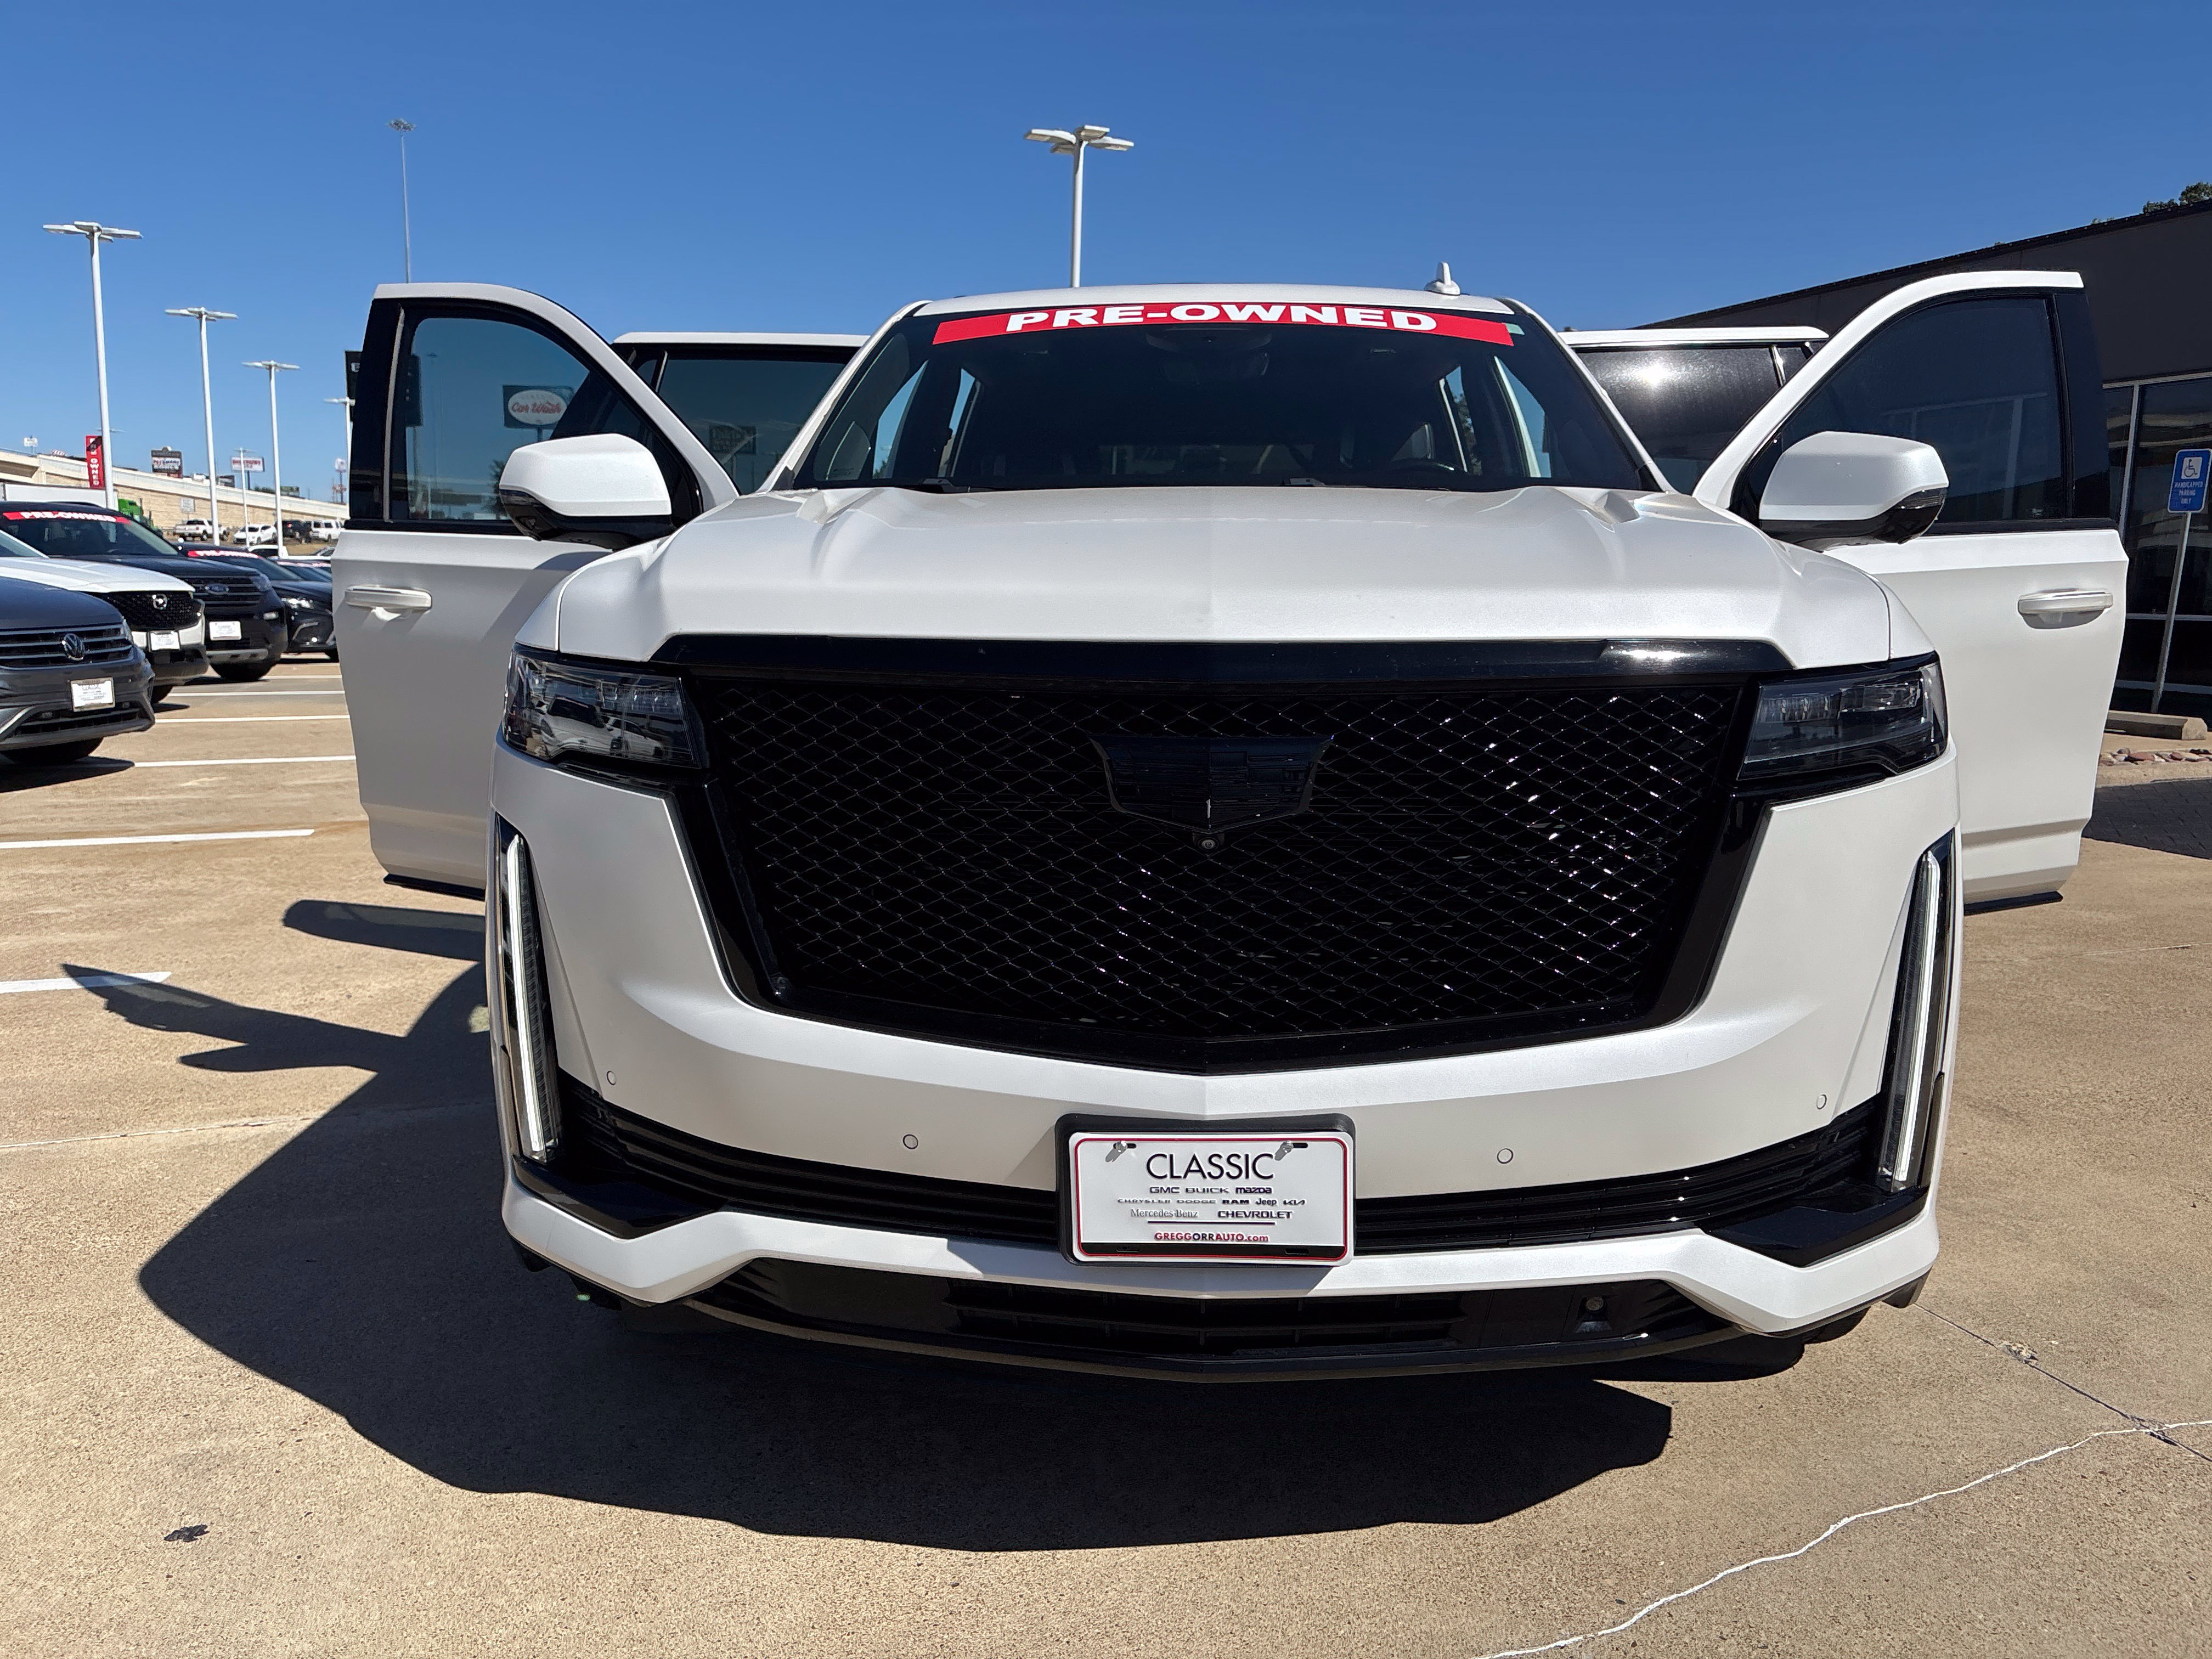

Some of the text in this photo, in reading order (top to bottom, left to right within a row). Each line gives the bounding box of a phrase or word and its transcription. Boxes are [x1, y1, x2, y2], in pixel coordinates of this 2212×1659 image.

[1006, 304, 1437, 332] PRE-OWNED
[512, 401, 561, 414] Car Wash
[20, 511, 117, 522] PRE-OWNED
[1146, 1153, 1274, 1180] CLASSIC
[1149, 1186, 1180, 1194] GMC
[1255, 1198, 1277, 1206] Jeep
[1130, 1209, 1293, 1219] Mercedes-Benz CHEVROLET
[1154, 1232, 1269, 1242] GREGGORRAUTO.com
